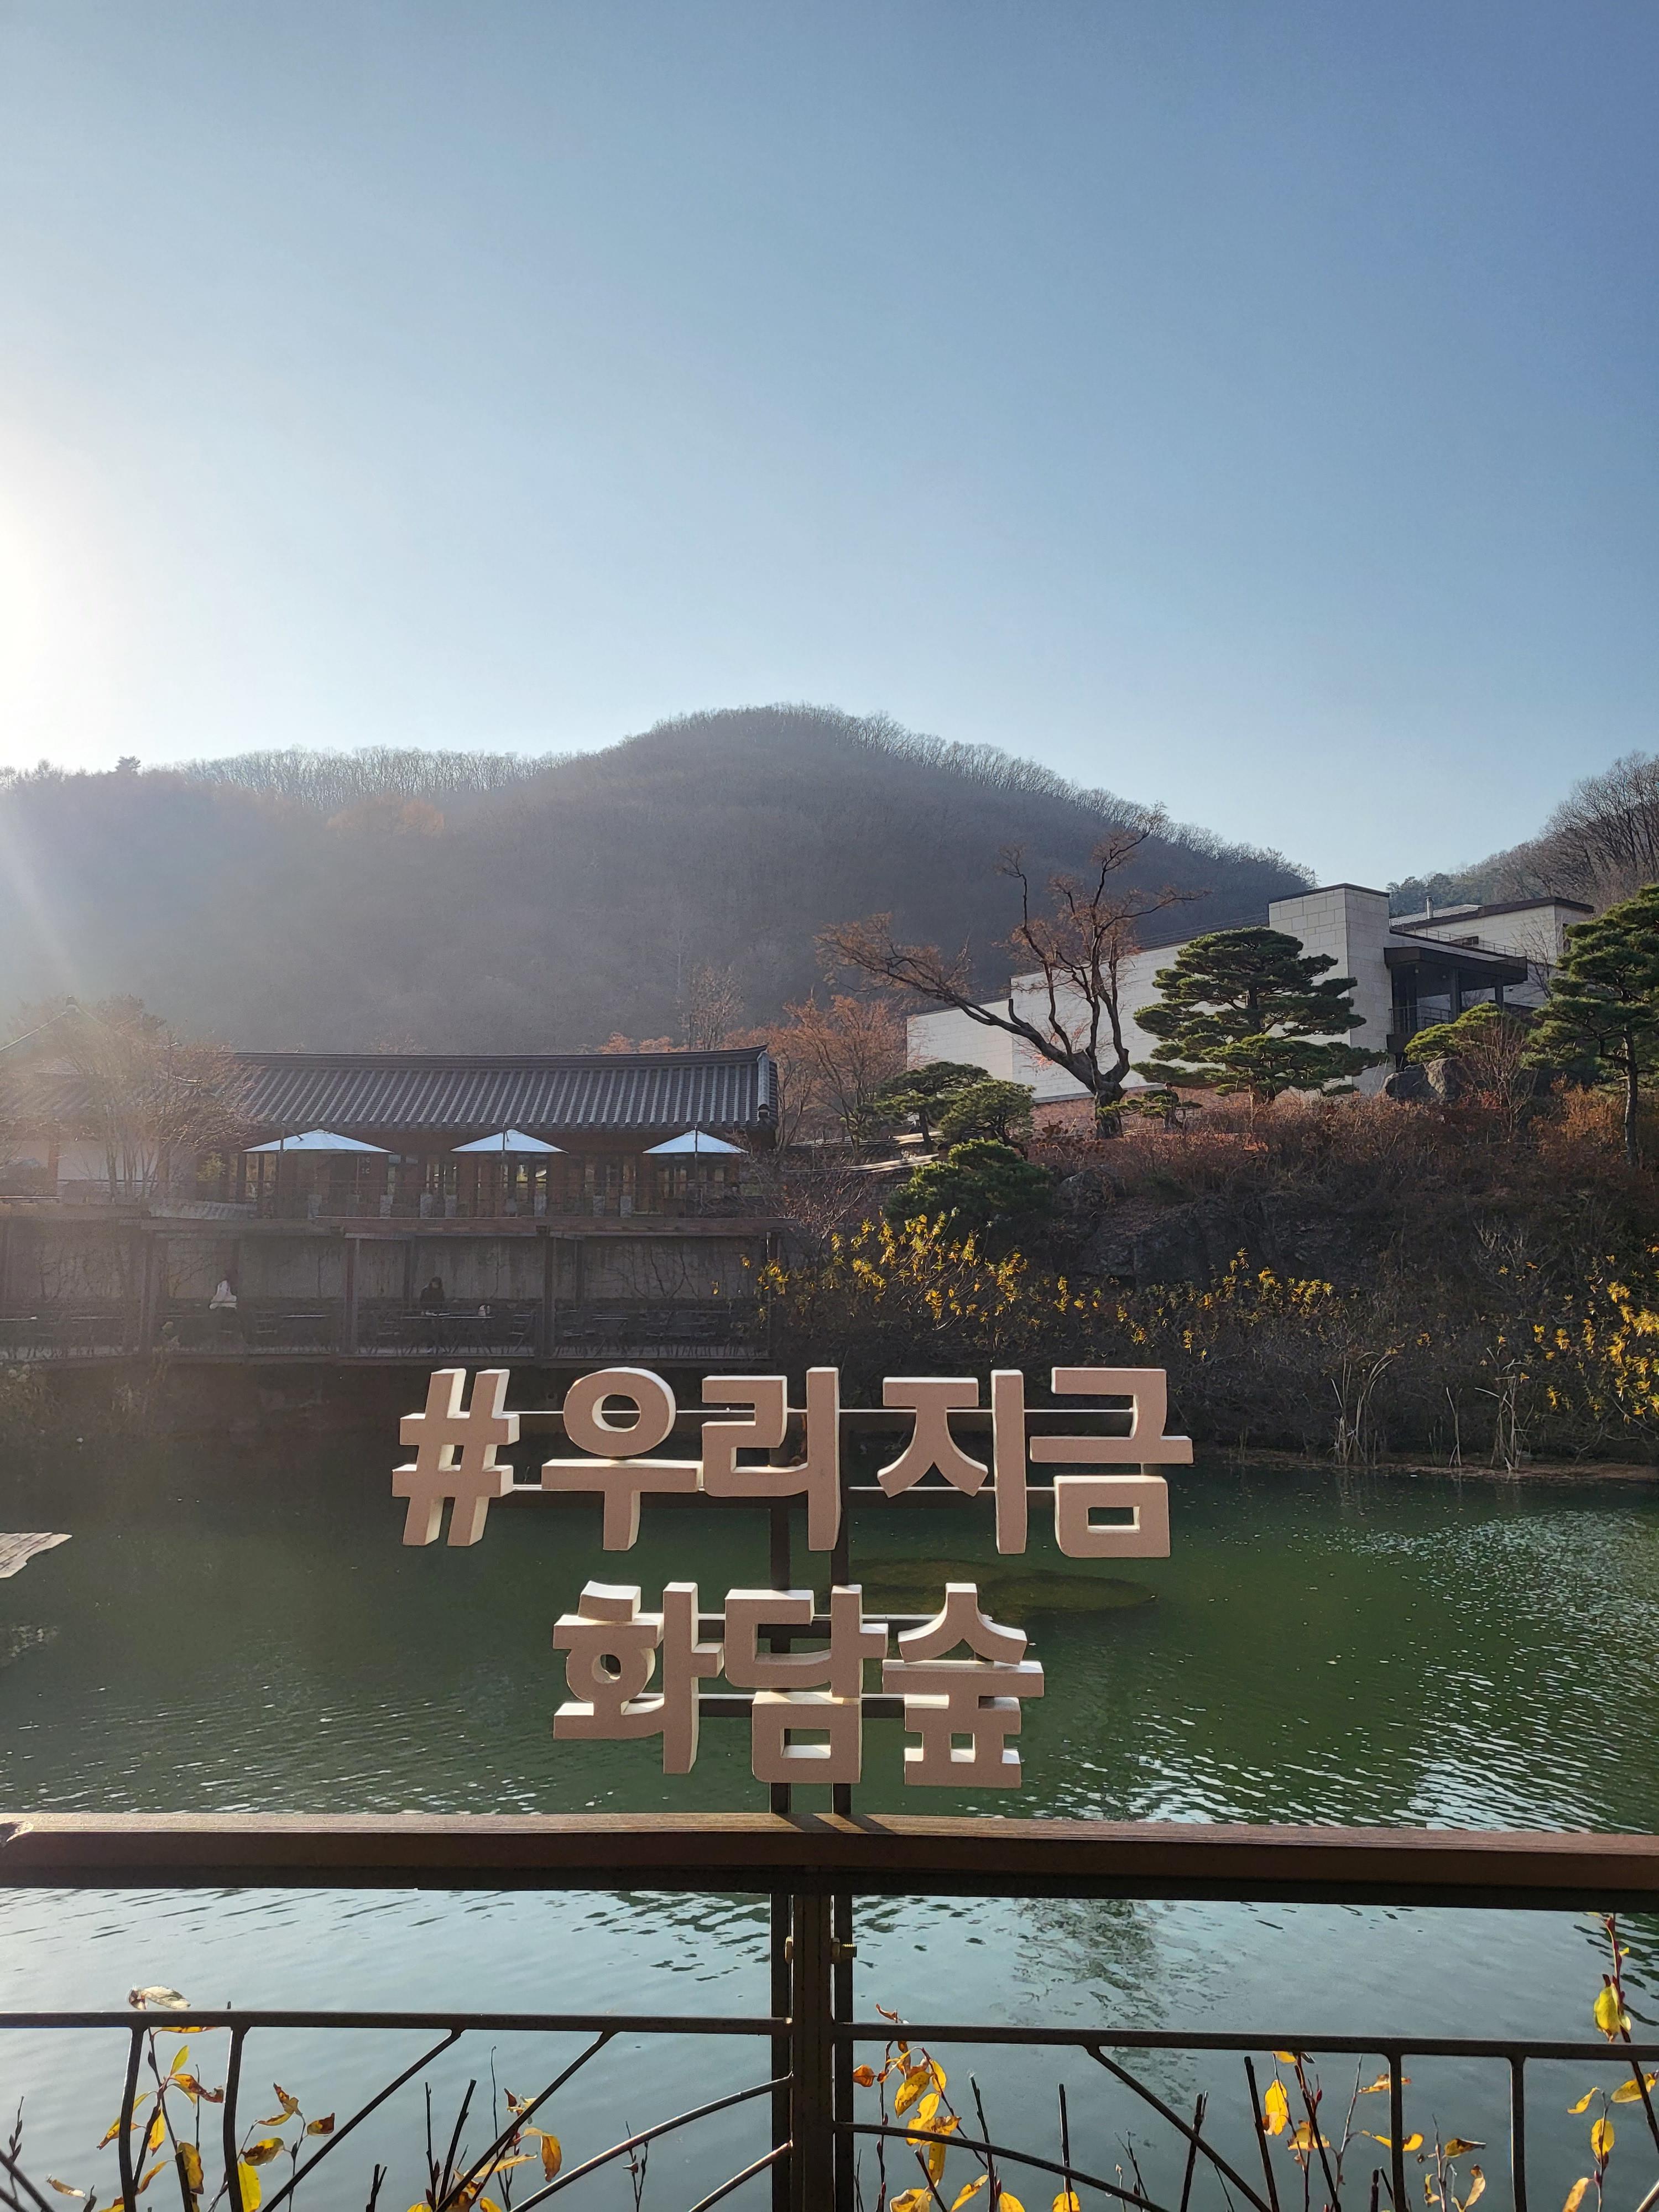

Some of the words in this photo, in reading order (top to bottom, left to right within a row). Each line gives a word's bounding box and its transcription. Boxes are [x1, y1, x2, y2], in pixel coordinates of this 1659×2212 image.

[392, 1367, 840, 1551] #우리
[878, 1367, 1193, 1558] 지금
[553, 1580, 1045, 1788] 화담숲
